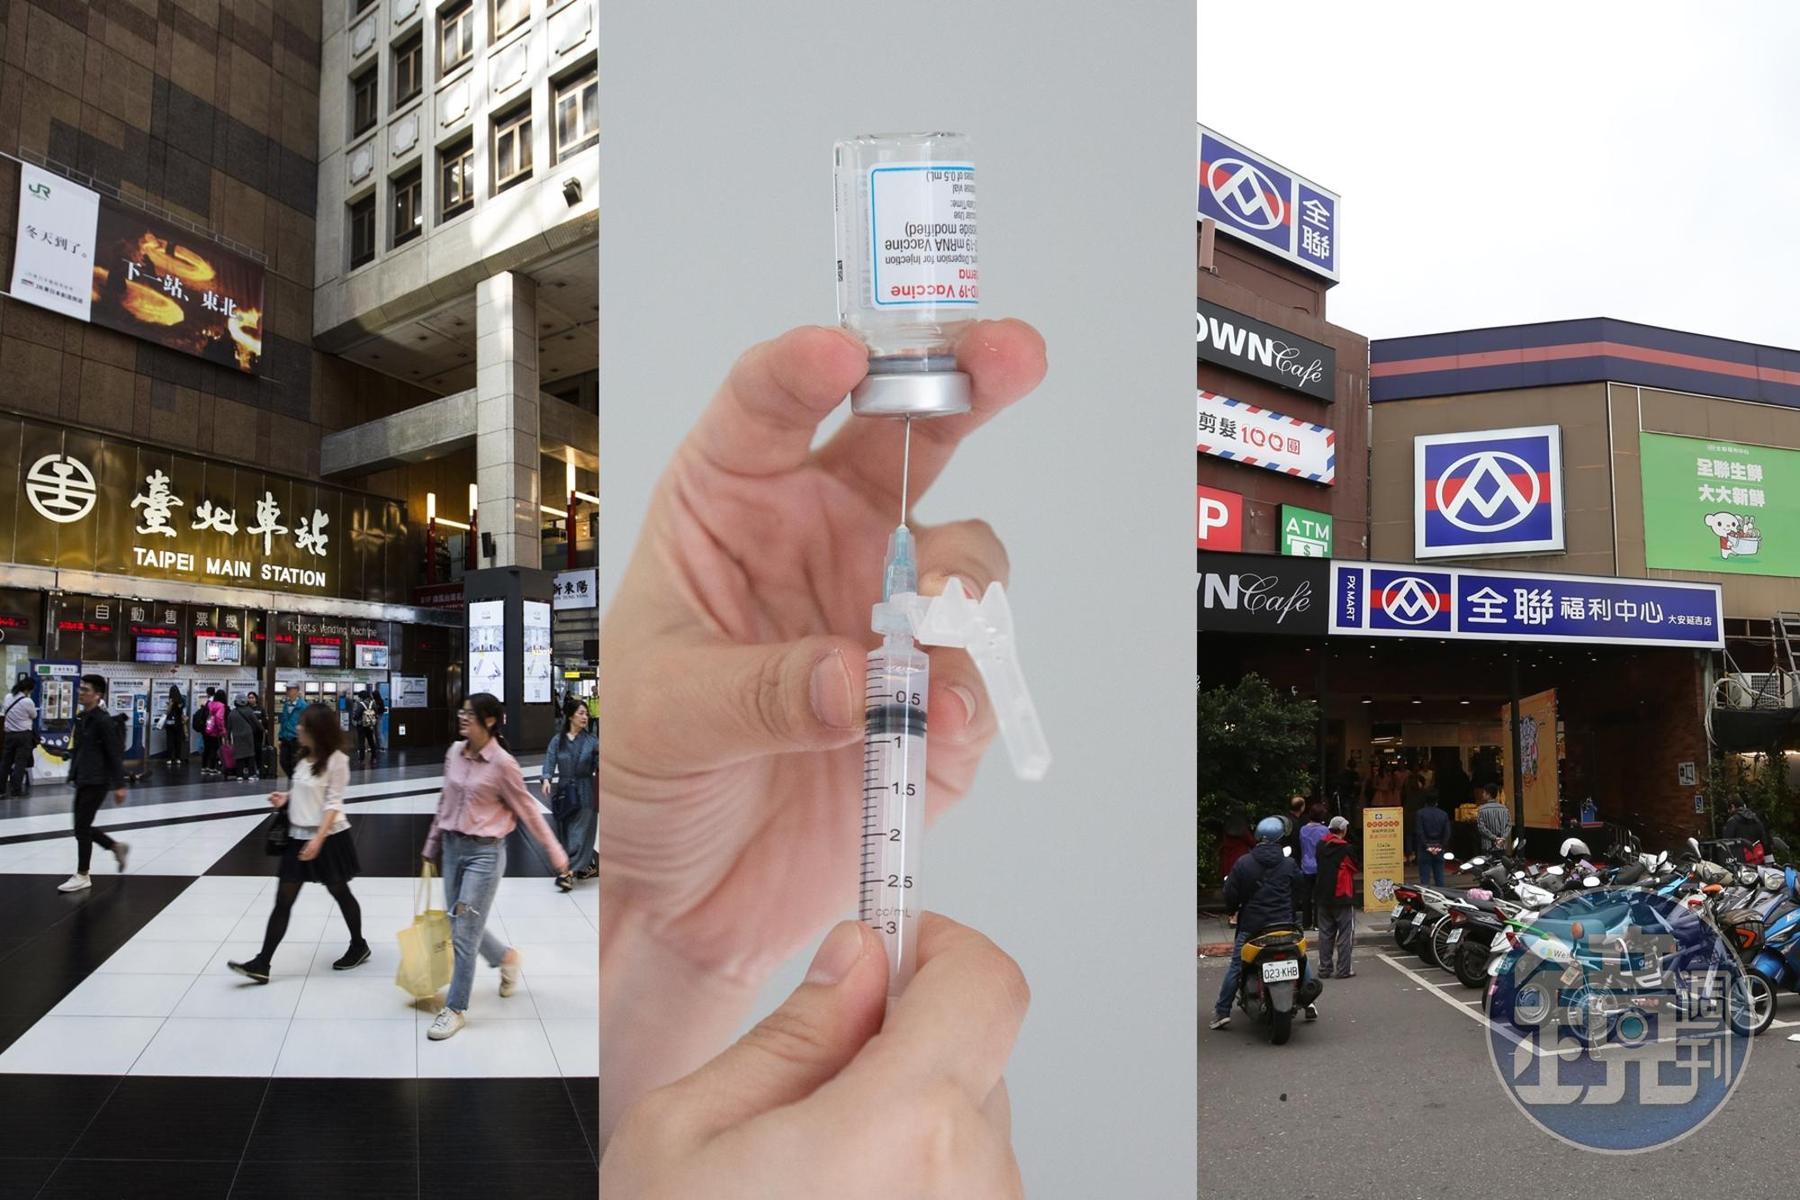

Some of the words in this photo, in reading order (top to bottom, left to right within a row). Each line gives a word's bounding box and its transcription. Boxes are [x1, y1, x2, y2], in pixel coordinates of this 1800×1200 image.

[944, 172, 956, 182] 0.5
[28, 183, 51, 199] JR
[905, 222, 957, 238] modified)
[1302, 199, 1330, 260] 全聯
[885, 238, 932, 252] Vaccine
[935, 239, 964, 252] mRNA
[885, 255, 920, 266] Injection
[923, 255, 935, 264] for
[937, 255, 969, 265] Dispersion
[891, 285, 955, 299] Vaccine
[1271, 340, 1322, 388] Café
[1698, 484, 1766, 507] 大大新鮮
[130, 469, 330, 557] 臺北車站
[1199, 497, 1229, 540] P
[1286, 517, 1330, 541] ATM
[133, 547, 194, 572] TAIPEI
[206, 557, 251, 578] MAIN
[261, 563, 326, 588] STATION
[1346, 576, 1355, 590] PX
[1197, 572, 1239, 610] N
[1239, 573, 1313, 624] Café
[1346, 591, 1355, 622] MART
[95, 604, 240, 630] 自動售票機
[895, 690, 921, 706] 0.5
[894, 736, 902, 748] 1
[892, 782, 916, 796] 1.5
[889, 829, 901, 841] 2
[887, 875, 913, 889] 2.5
[885, 922, 897, 935] 3
